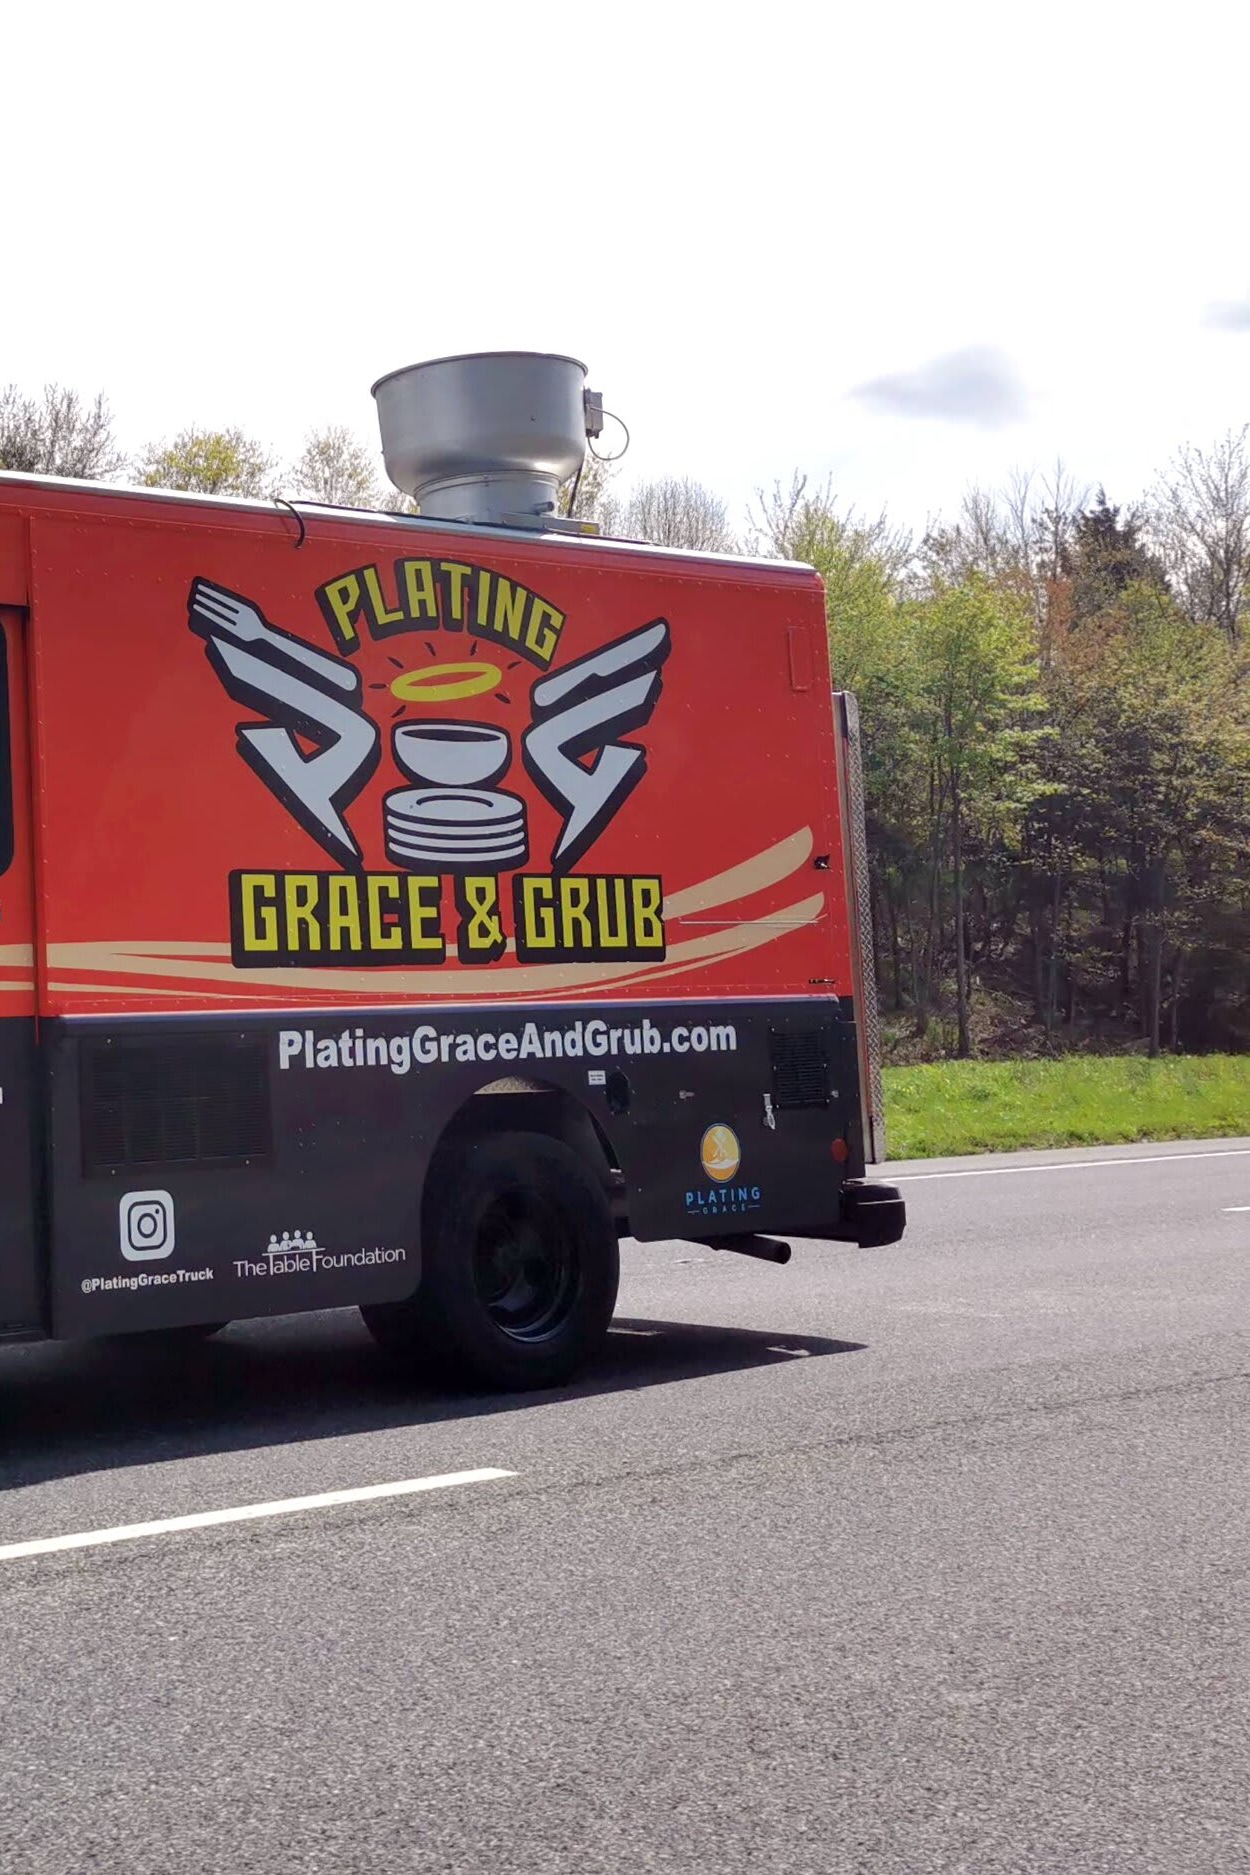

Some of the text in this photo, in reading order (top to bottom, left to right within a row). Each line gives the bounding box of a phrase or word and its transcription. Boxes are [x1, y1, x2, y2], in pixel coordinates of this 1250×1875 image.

[325, 561, 564, 661] PLATING
[241, 872, 663, 952] GRACE & GRUB
[279, 1019, 737, 1075] PlatingGraceAndGrub.com
[686, 1187, 760, 1206] PLATING
[702, 1204, 746, 1215] GRACE
[81, 1268, 214, 1293] @PlatingGraceTruck
